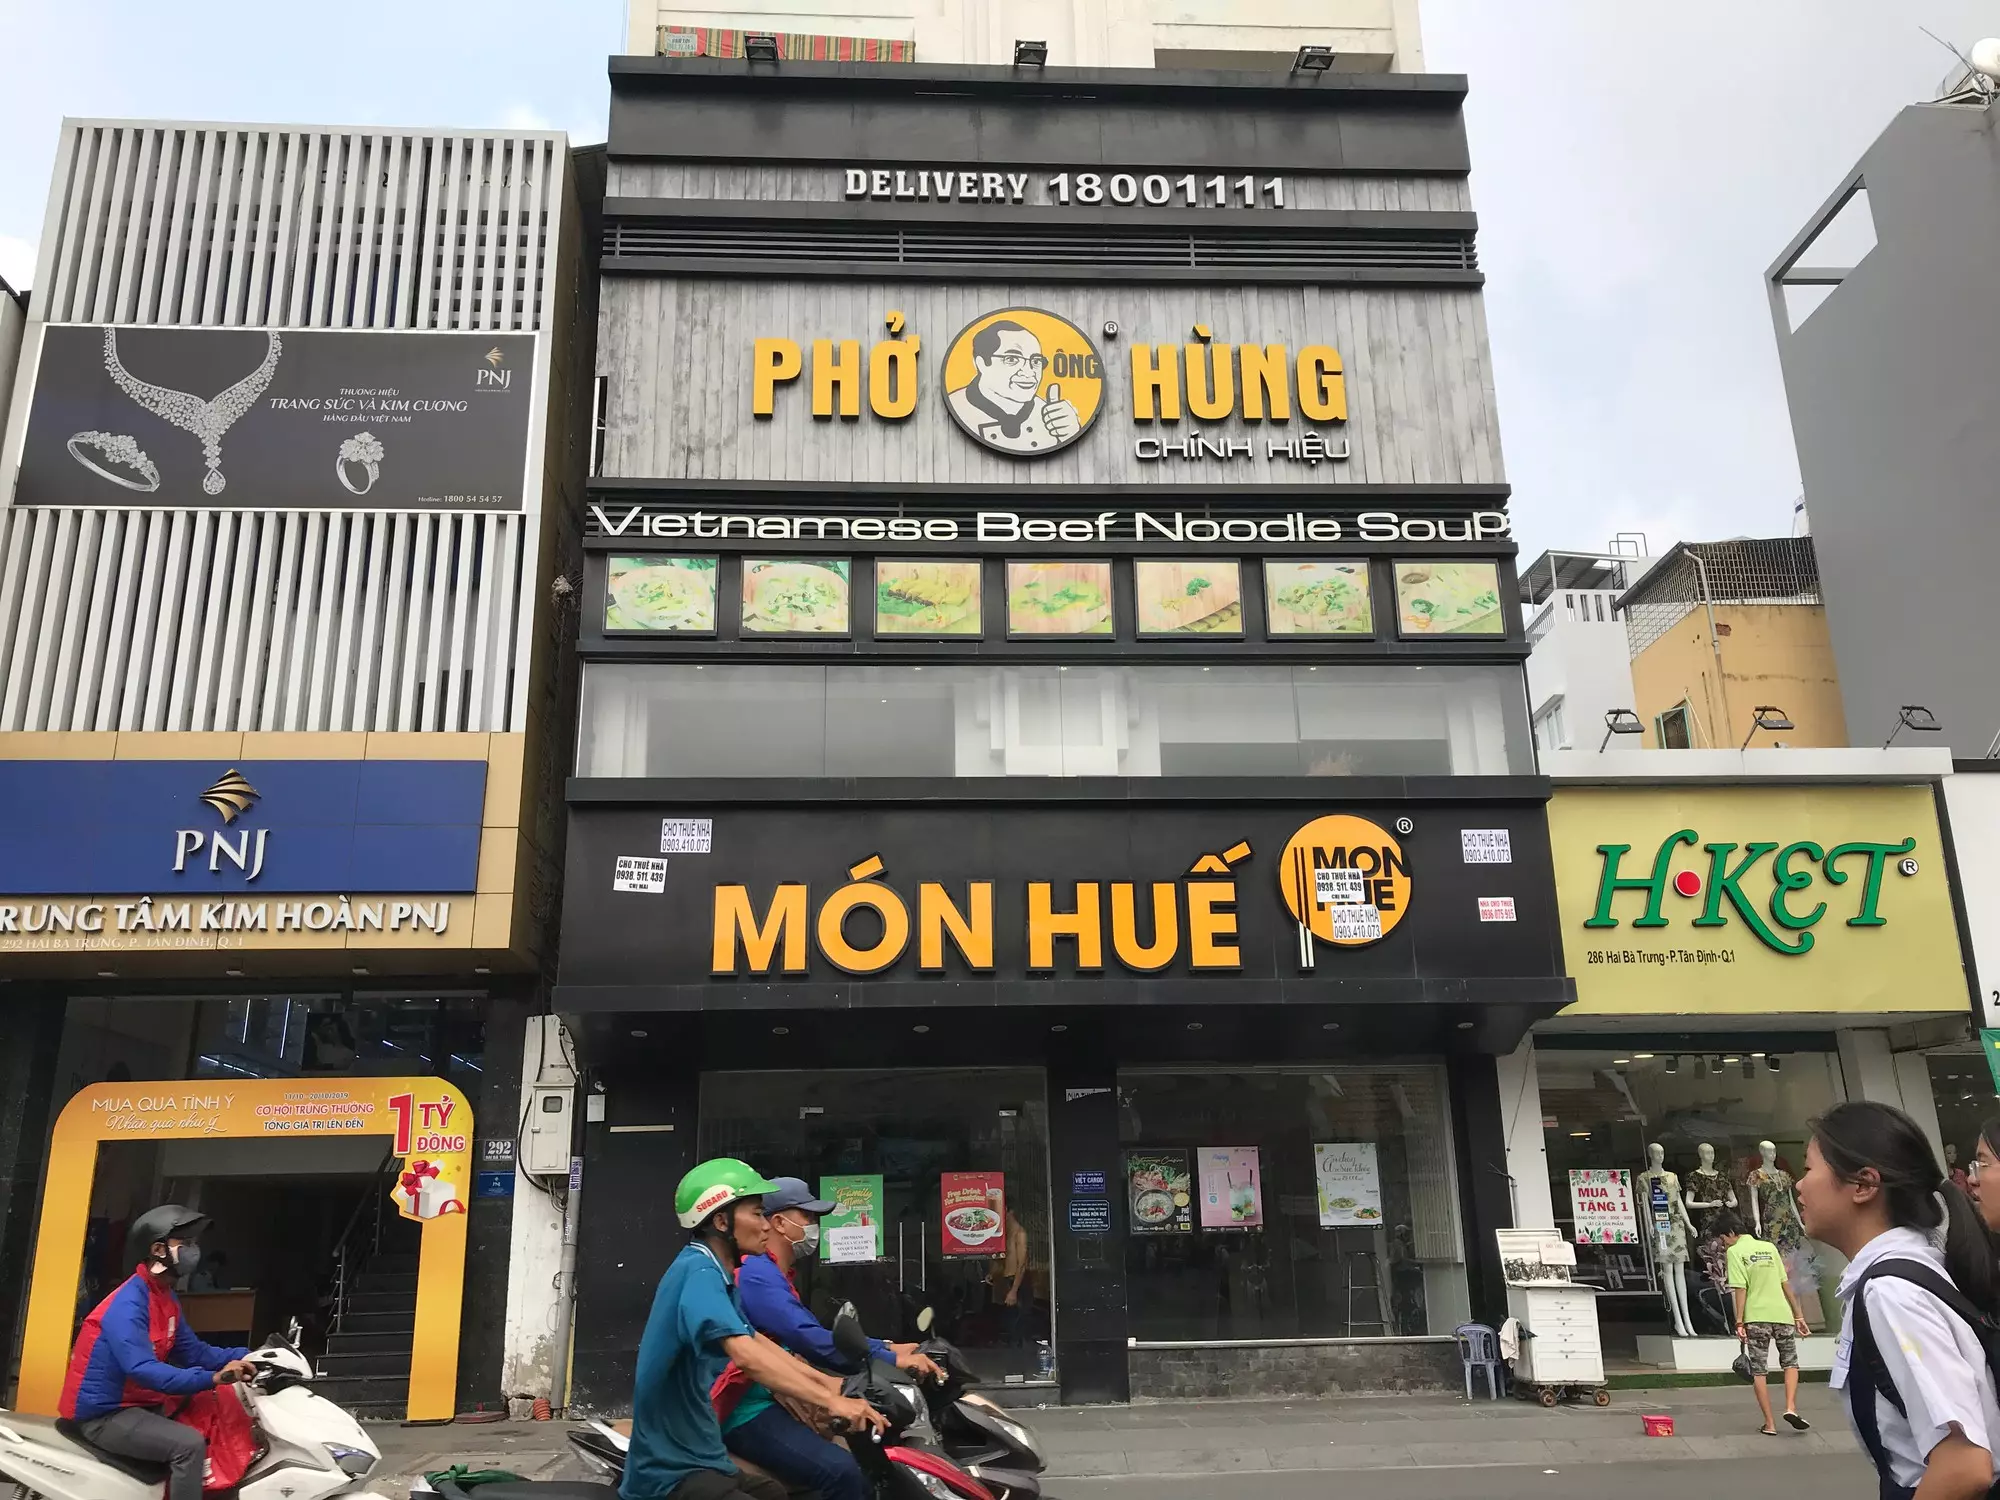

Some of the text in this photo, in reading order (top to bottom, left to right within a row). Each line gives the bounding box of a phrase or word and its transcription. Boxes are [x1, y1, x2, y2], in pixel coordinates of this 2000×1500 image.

[844, 169, 1285, 208] DELIVERY 18001111
[753, 310, 1348, 424] PHỞ ÔNG HÙNG
[477, 369, 512, 389] PNJ
[270, 398, 321, 410] TRANG
[359, 398, 376, 411] VÀ
[380, 399, 410, 411] KIM
[323, 413, 349, 422] HÀNG
[370, 414, 391, 423] VIỆT
[391, 415, 412, 423] NAM
[1134, 430, 1351, 467] CHÍNH HIỆU
[444, 495, 464, 503] 1800
[466, 495, 477, 503] 54
[479, 495, 490, 503] 54
[492, 495, 503, 503] 57
[590, 505, 958, 541] Vietnamese
[976, 511, 1119, 542] Beef
[1134, 511, 1343, 542] Noodle
[663, 823, 678, 837] CHO
[662, 839, 710, 852] 0903.410.073
[1463, 834, 1477, 847] CHO
[172, 829, 270, 881] PNJ
[1465, 849, 1511, 862] 0903.410.073
[618, 859, 632, 869] CHO
[650, 872, 664, 883] 439
[1317, 872, 1330, 881] CHO
[1350, 882, 1363, 892] 439
[114, 896, 193, 933] TÂM
[200, 902, 269, 932] KIM
[276, 894, 386, 932] HOÀN
[390, 902, 450, 934] PNJ
[711, 838, 1254, 976] MÓN HUẾ
[1333, 909, 1347, 923] CHO
[1334, 925, 1381, 939] 0903.410.073
[2, 939, 23, 949] 292
[1587, 950, 1604, 964] 286
[1606, 950, 1621, 964] Hai
[1623, 950, 1636, 964] Bà
[92, 1097, 134, 1112] MUA
[138, 1094, 177, 1112] QUÀ
[183, 1093, 220, 1110] TÌNH
[273, 1103, 293, 1117] HỘI
[296, 1102, 328, 1115] TRÚNG
[106, 1112, 147, 1132] Nhận
[149, 1118, 176, 1133] quà
[293, 1118, 310, 1130] GIÁ
[312, 1119, 325, 1130] TRỊ
[327, 1118, 343, 1129] LÊN
[345, 1116, 364, 1129] ĐẾN
[388, 1092, 456, 1154] 1 TỶ
[416, 1131, 466, 1152] ĐỒNG
[487, 1141, 512, 1155] 292
[836, 1186, 873, 1202] Family
[1578, 1187, 1626, 1198] MUA 1
[696, 1189, 728, 1213] SUBARU
[1578, 1200, 1629, 1214] TẶNG 1
